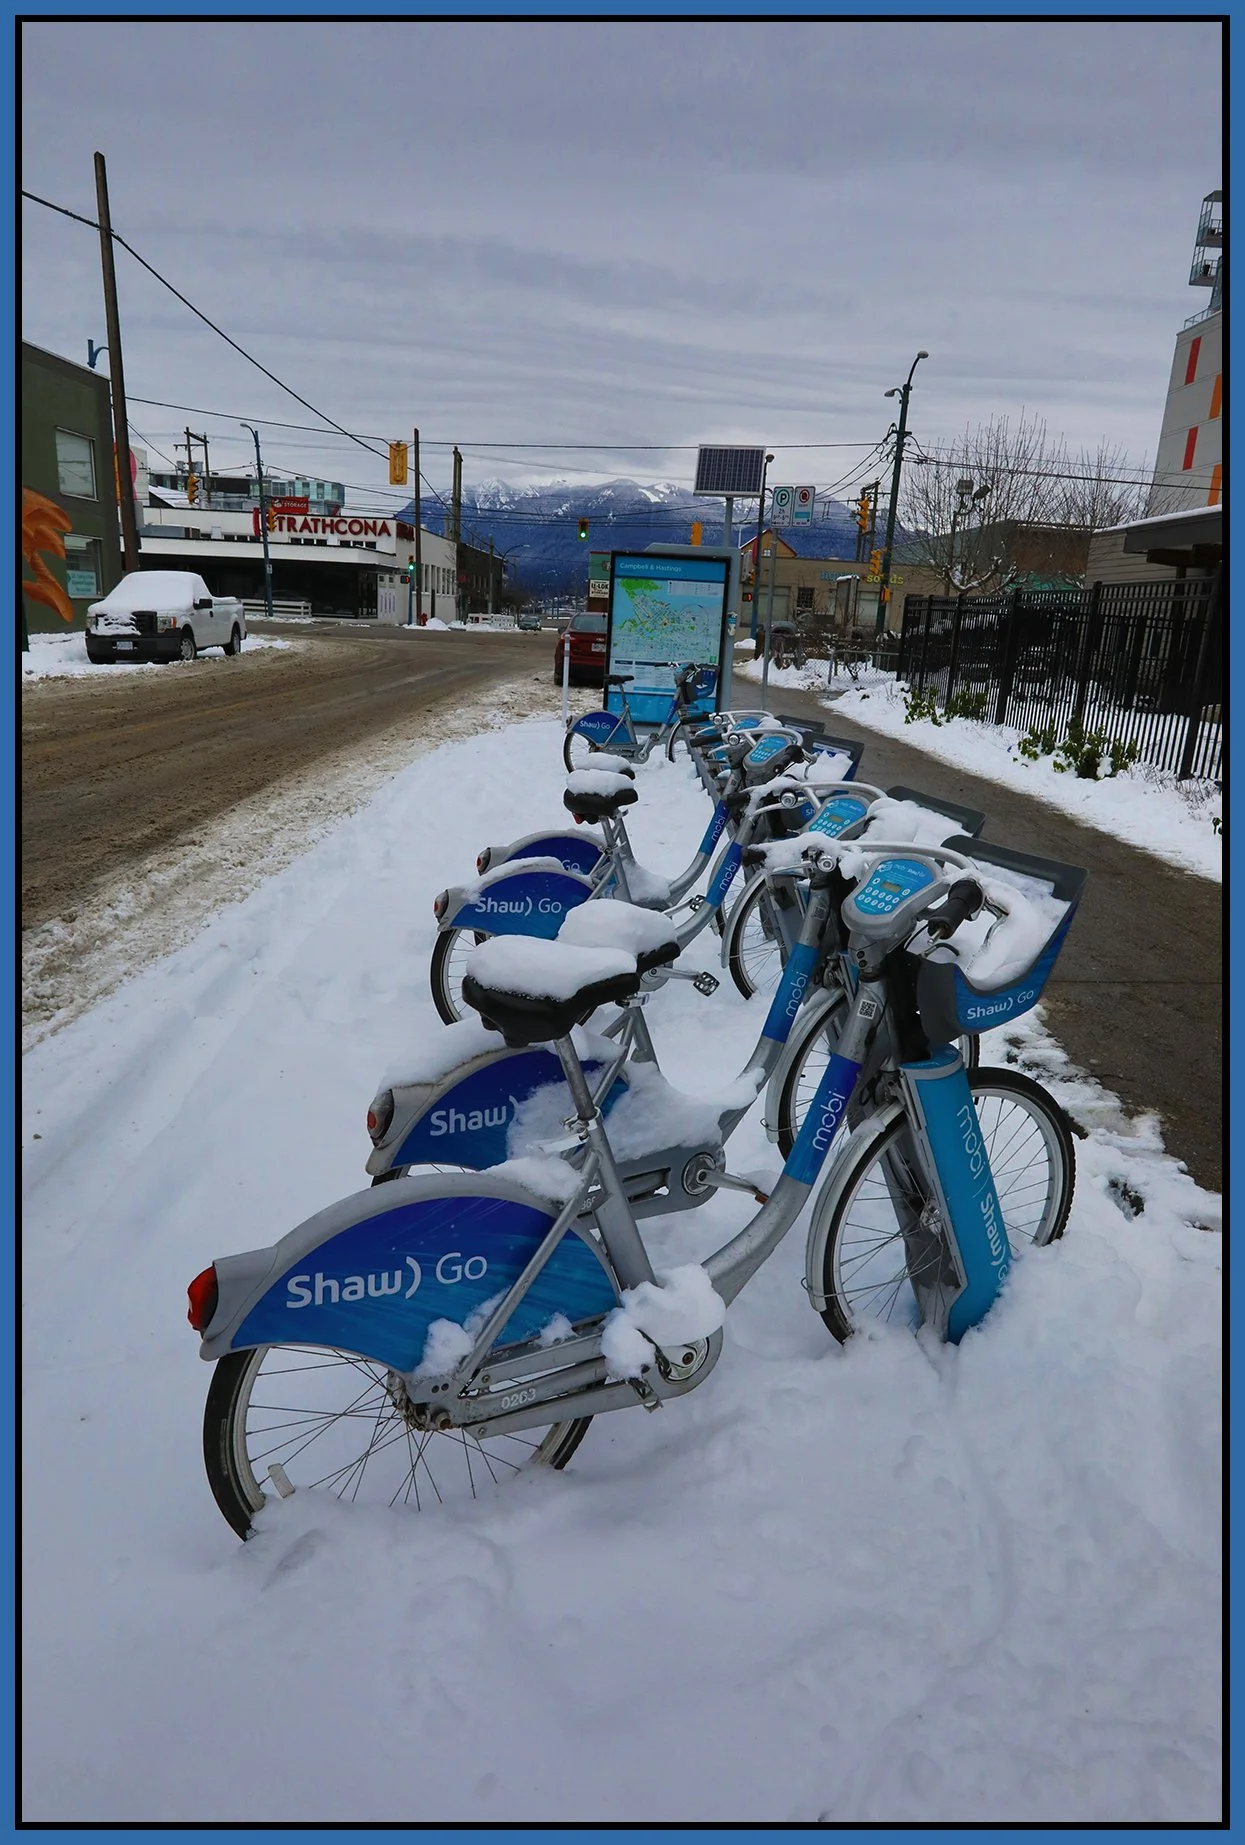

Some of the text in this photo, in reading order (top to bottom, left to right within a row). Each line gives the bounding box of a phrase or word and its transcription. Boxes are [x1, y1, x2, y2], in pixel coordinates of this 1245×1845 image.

[780, 493, 787, 503] P
[620, 562, 649, 570] Campbell
[656, 564, 682, 573] Hastings
[867, 573, 904, 585] sods
[601, 722, 611, 730] Go
[711, 815, 727, 842] mobi
[561, 859, 580, 872] Go
[719, 862, 738, 891] mobi
[538, 898, 562, 914] Go
[785, 971, 809, 1018] mobi
[1017, 988, 1035, 1004] Go
[812, 1087, 847, 1152] mobi
[956, 1104, 988, 1180] mobi
[435, 1251, 488, 1285] Go
[501, 1387, 537, 1410] 0263
